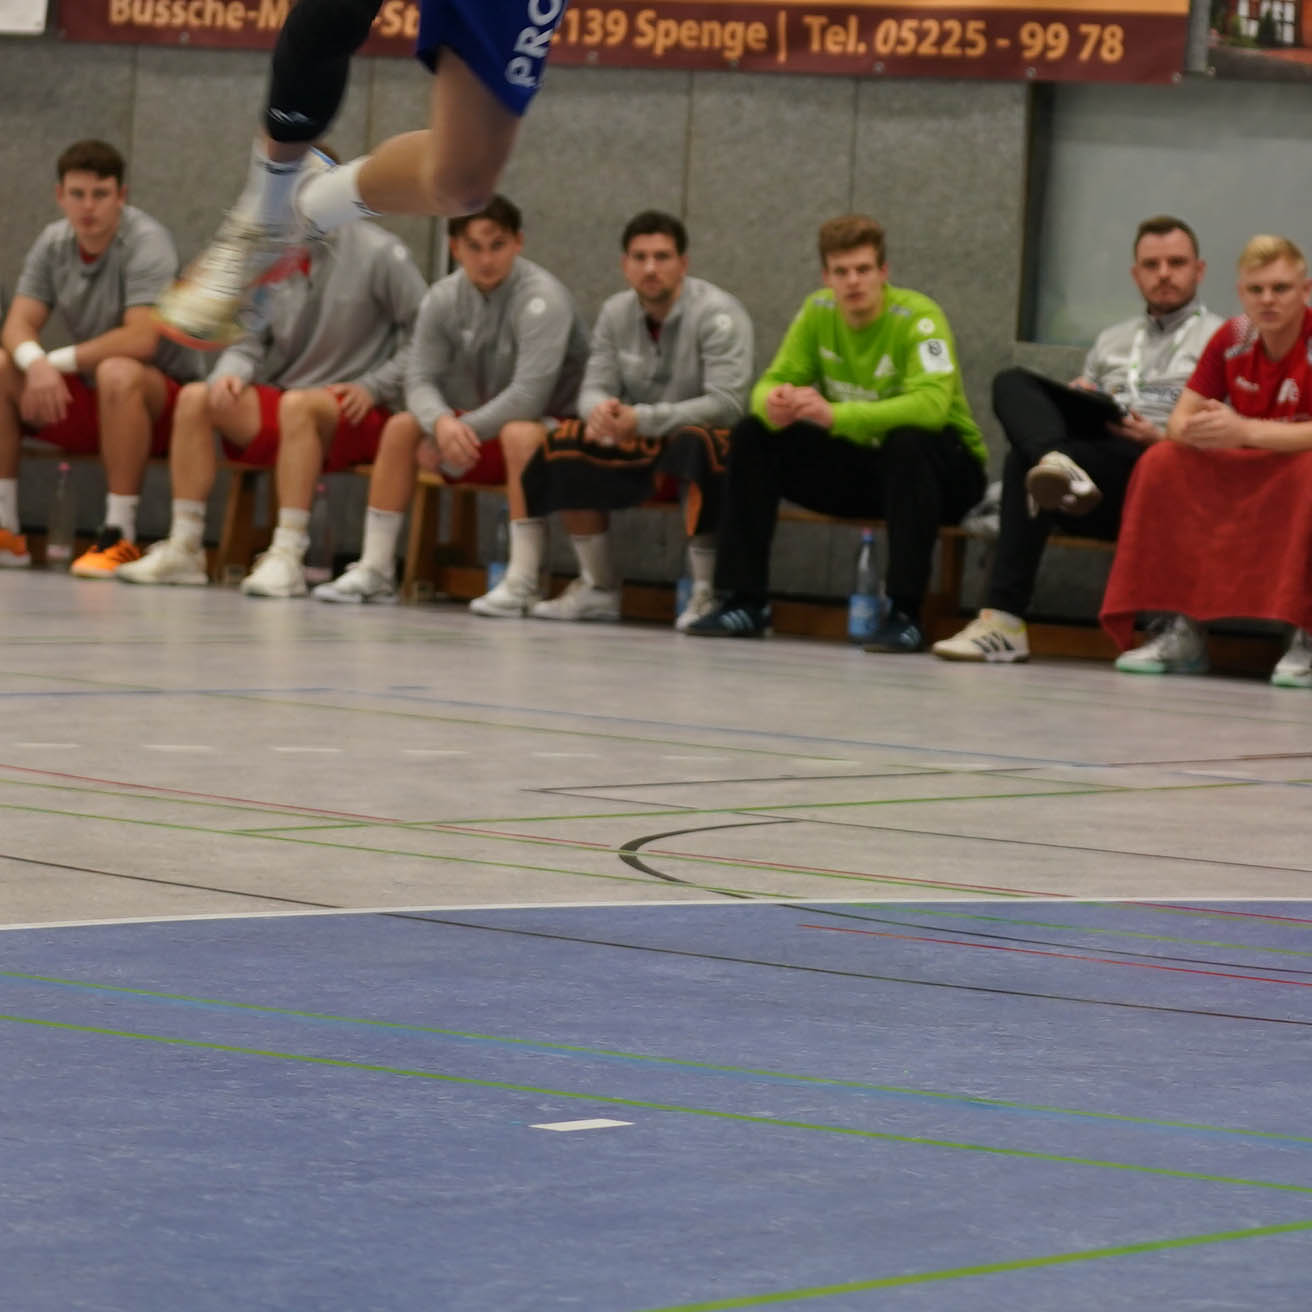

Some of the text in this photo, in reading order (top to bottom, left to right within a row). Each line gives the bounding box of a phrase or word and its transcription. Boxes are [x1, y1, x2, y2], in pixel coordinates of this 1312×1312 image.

[635, 11, 769, 57] Spenge
[804, 16, 867, 54] Tel.
[875, 17, 986, 56] 05225
[1021, 22, 1070, 60] 99
[1079, 24, 1125, 62] 78
